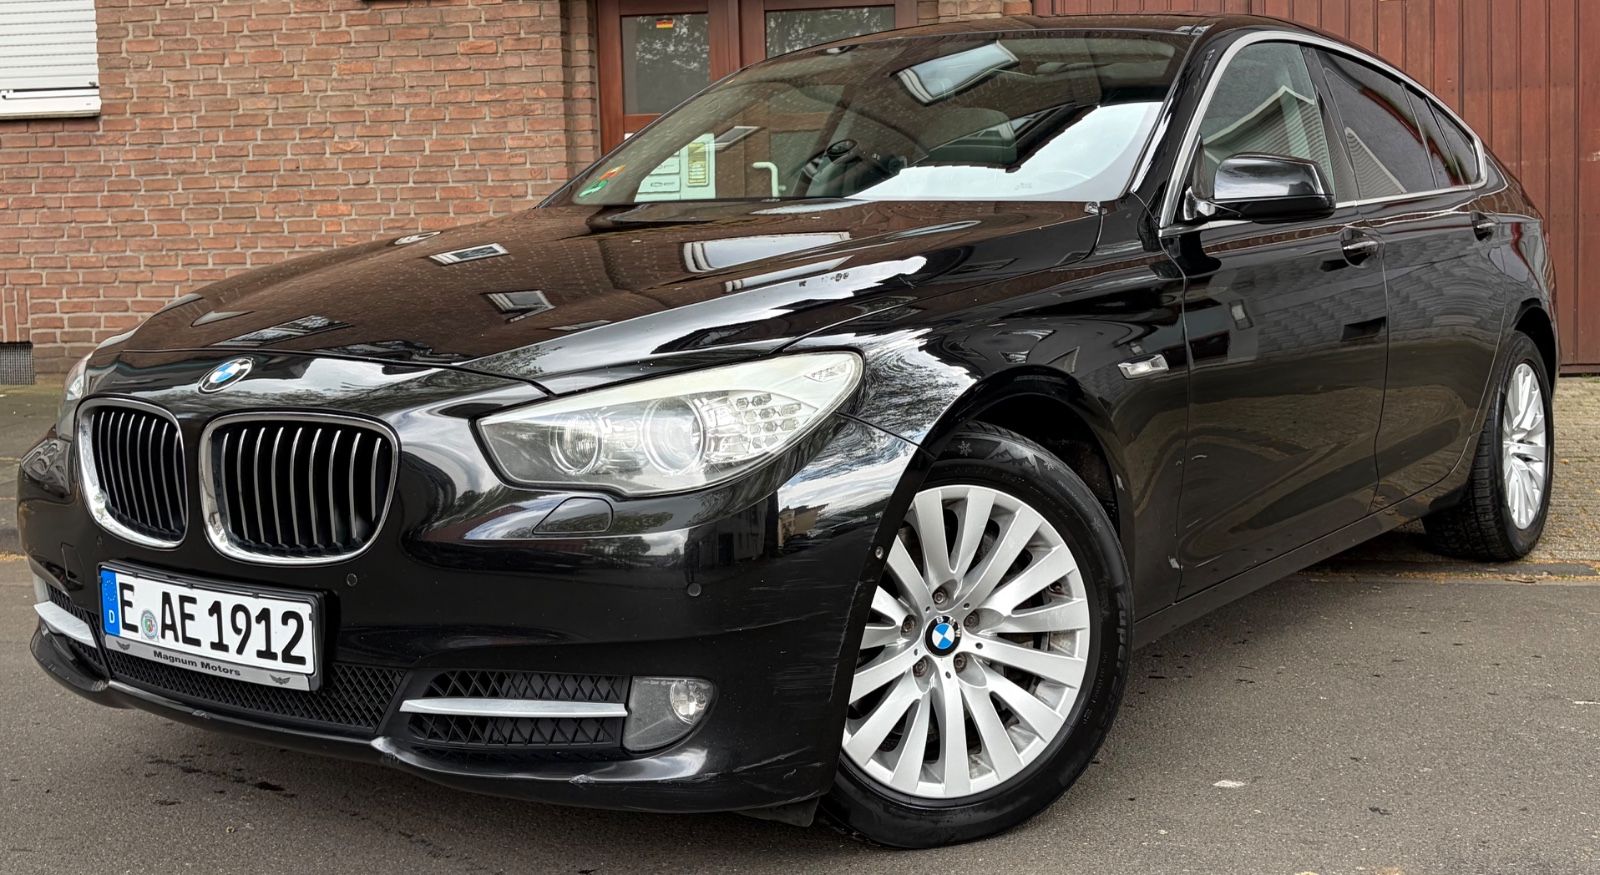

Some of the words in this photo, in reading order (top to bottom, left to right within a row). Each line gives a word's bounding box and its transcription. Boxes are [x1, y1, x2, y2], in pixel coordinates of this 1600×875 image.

[109, 610, 116, 624] D
[119, 583, 138, 633] E
[161, 591, 201, 647] AE
[208, 600, 306, 665] 1912
[153, 650, 197, 666] Magnum
[200, 661, 241, 676] Motors
